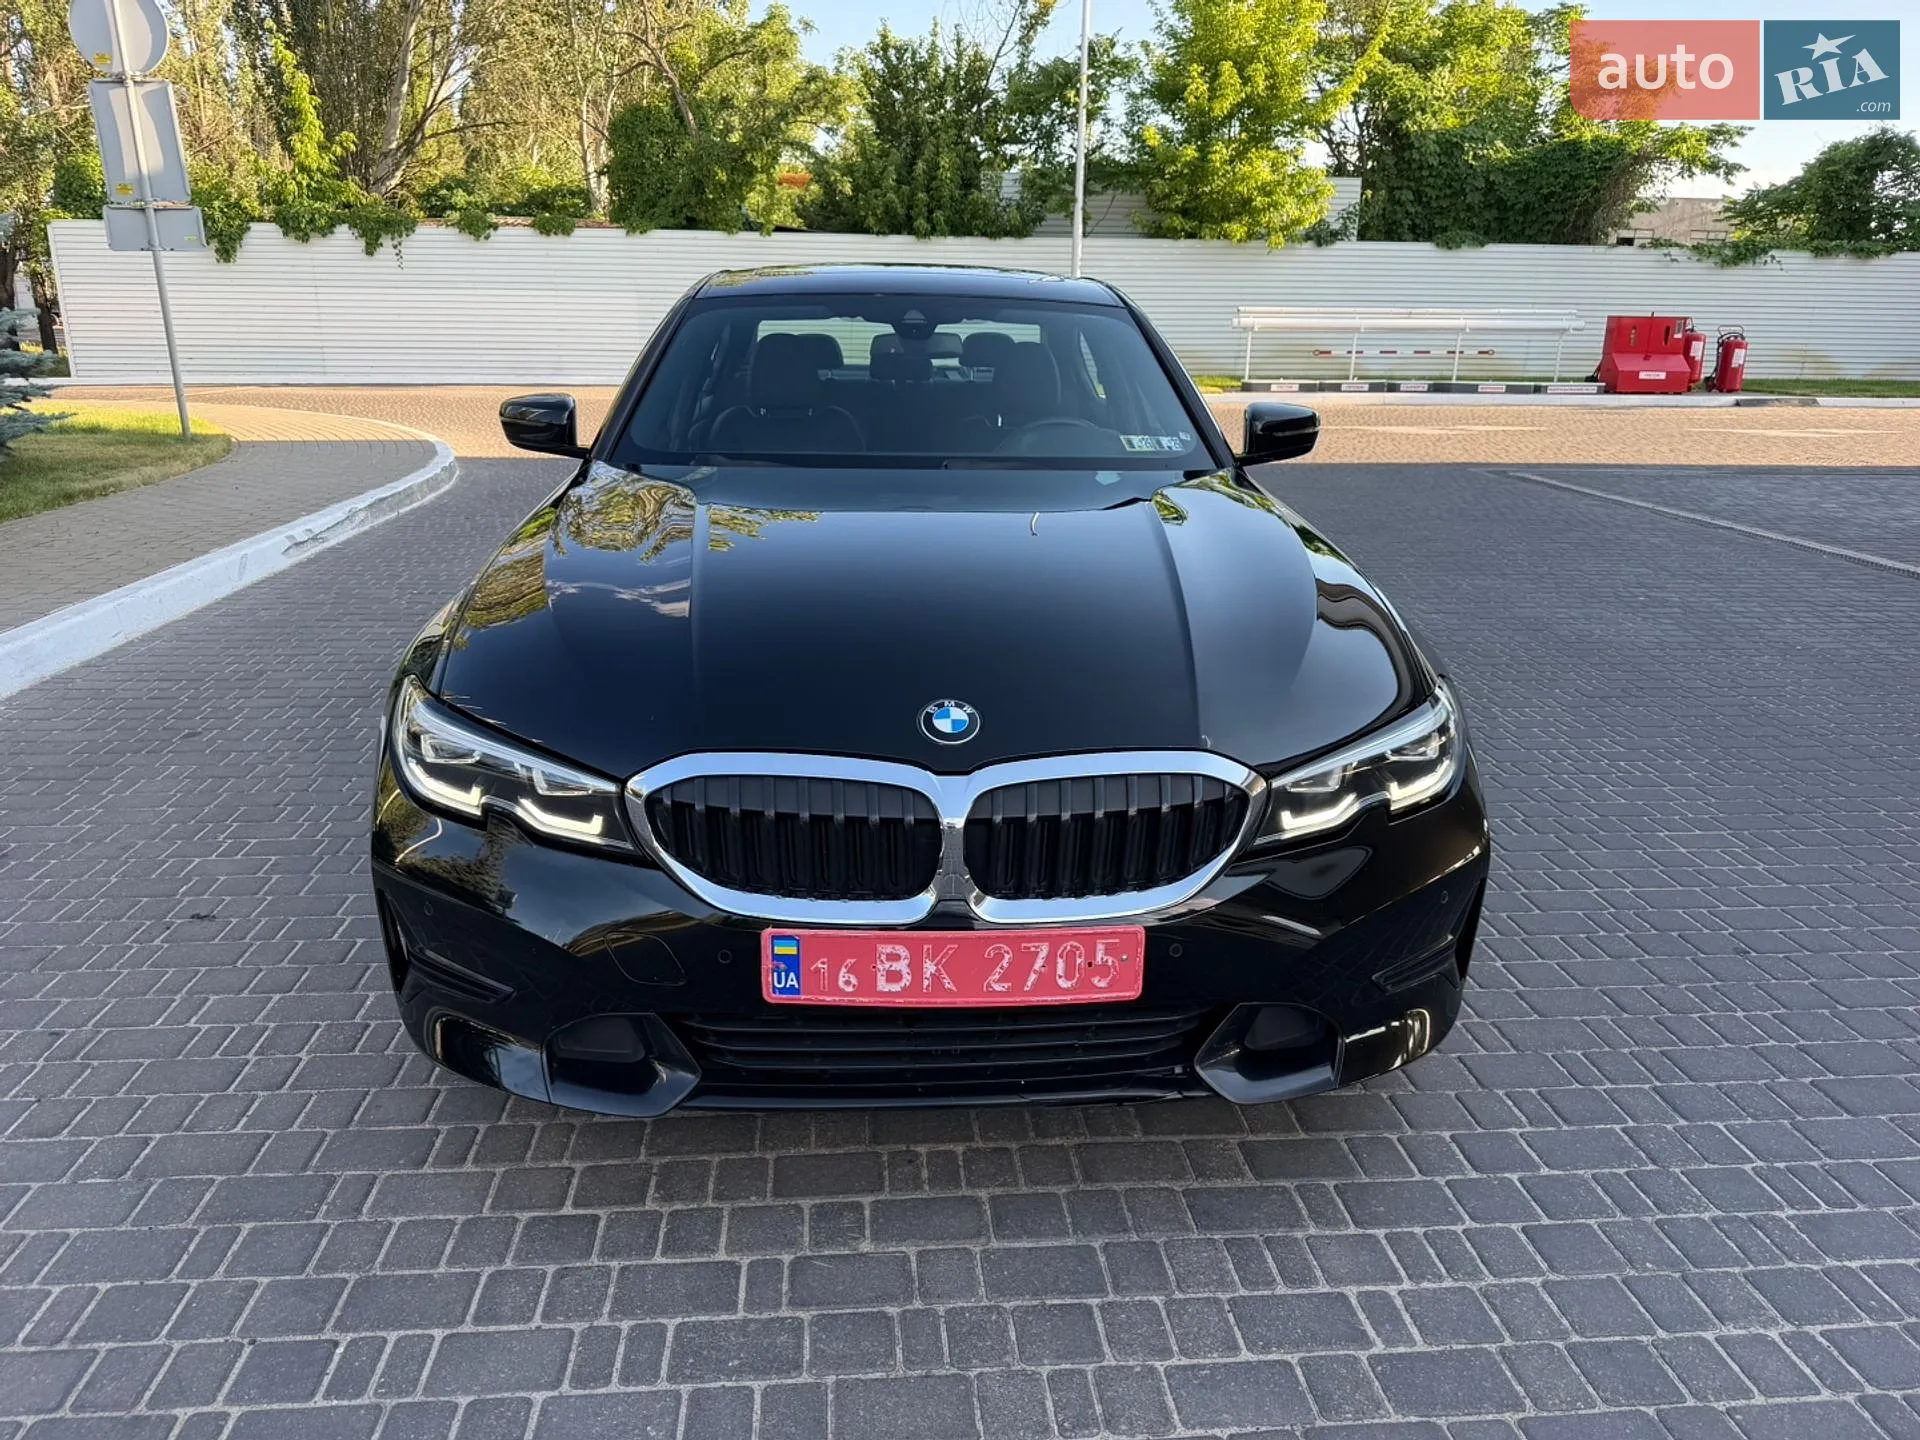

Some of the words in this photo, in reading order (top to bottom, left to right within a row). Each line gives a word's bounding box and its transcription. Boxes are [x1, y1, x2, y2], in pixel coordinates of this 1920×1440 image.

[925, 700, 974, 714] BMW
[810, 957, 859, 992] 16
[983, 938, 1121, 992] 2705
[773, 971, 799, 988] UA
